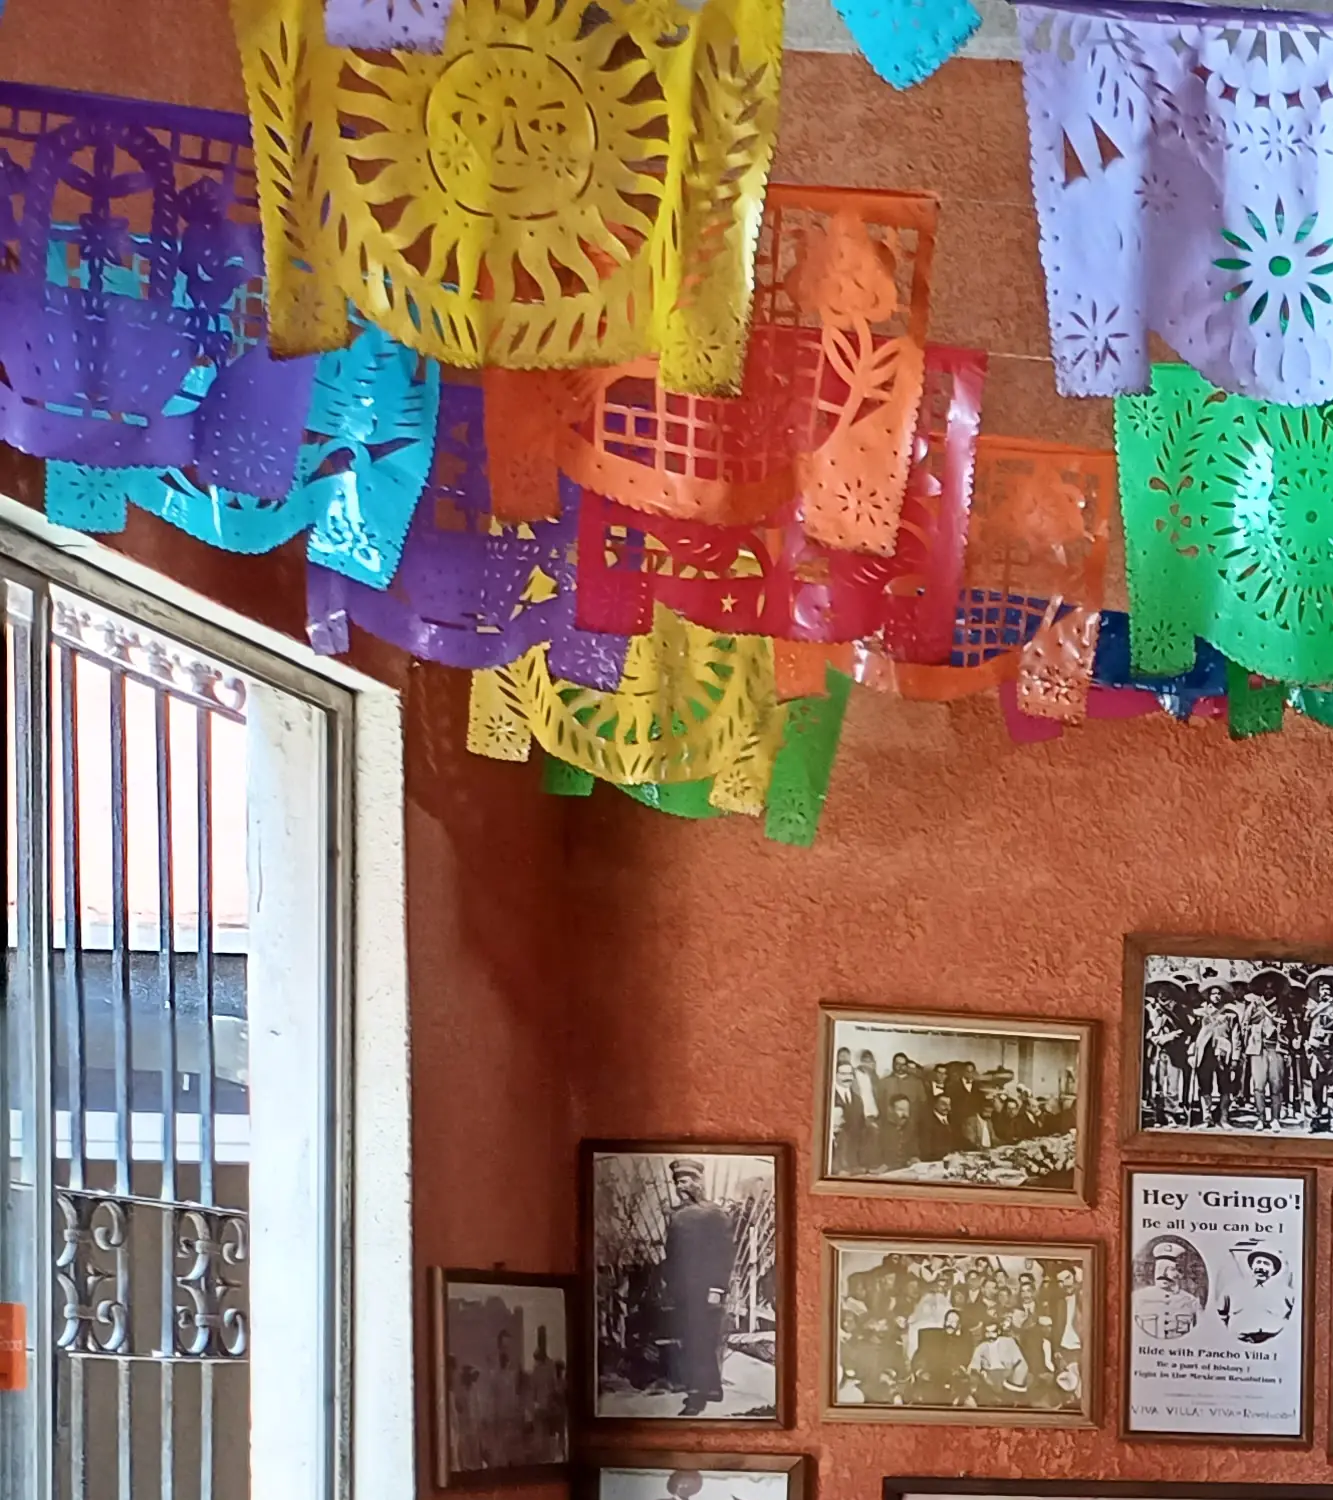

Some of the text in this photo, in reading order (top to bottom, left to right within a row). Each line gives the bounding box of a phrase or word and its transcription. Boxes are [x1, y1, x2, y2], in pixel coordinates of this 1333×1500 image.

[1143, 1189, 1189, 1210] Hey
[1142, 1218, 1161, 1229] Be
[1167, 1219, 1185, 1230] all
[1190, 1221, 1218, 1233] you
[1223, 1223, 1249, 1232] can
[1255, 1222, 1273, 1233] be
[1138, 1346, 1165, 1356] Ride
[1169, 1347, 1194, 1357] with
[1198, 1349, 1240, 1359] Pancho
[1244, 1350, 1270, 1360] Villa
[1179, 1362, 1199, 1370] part
[1201, 1363, 1211, 1371] of
[1213, 1364, 1243, 1373] history
[1134, 1370, 1157, 1379] Fight
[1189, 1373, 1226, 1381] Mexican
[1228, 1374, 1276, 1384] Revolution
[1131, 1405, 1158, 1415] VIVA
